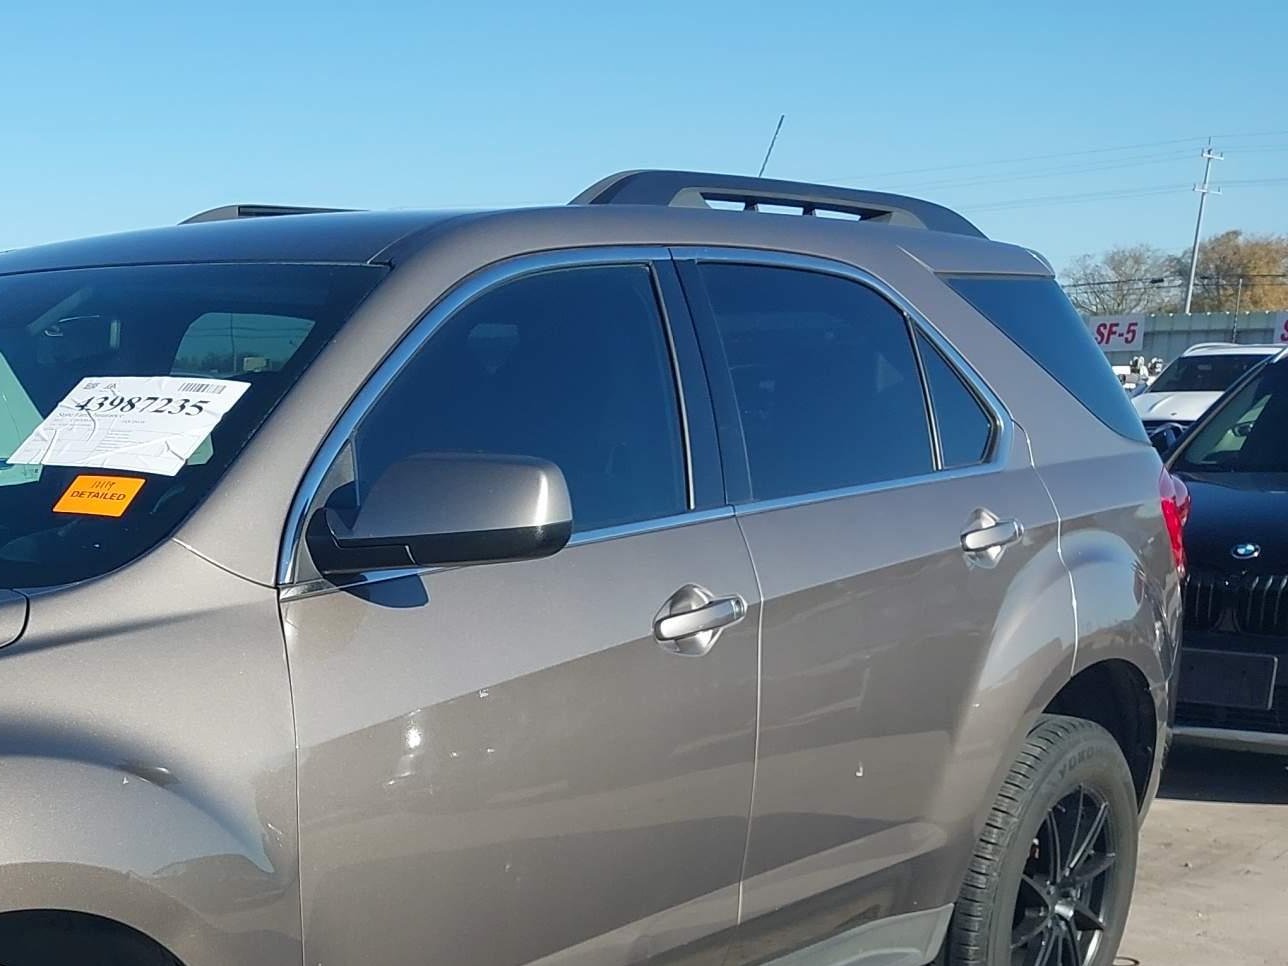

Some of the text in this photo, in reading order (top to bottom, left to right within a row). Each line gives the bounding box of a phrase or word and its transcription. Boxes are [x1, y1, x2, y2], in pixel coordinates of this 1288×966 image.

[1094, 322, 1138, 345] SF-5
[75, 396, 210, 416] 43987235
[70, 490, 127, 501] DETAILED
